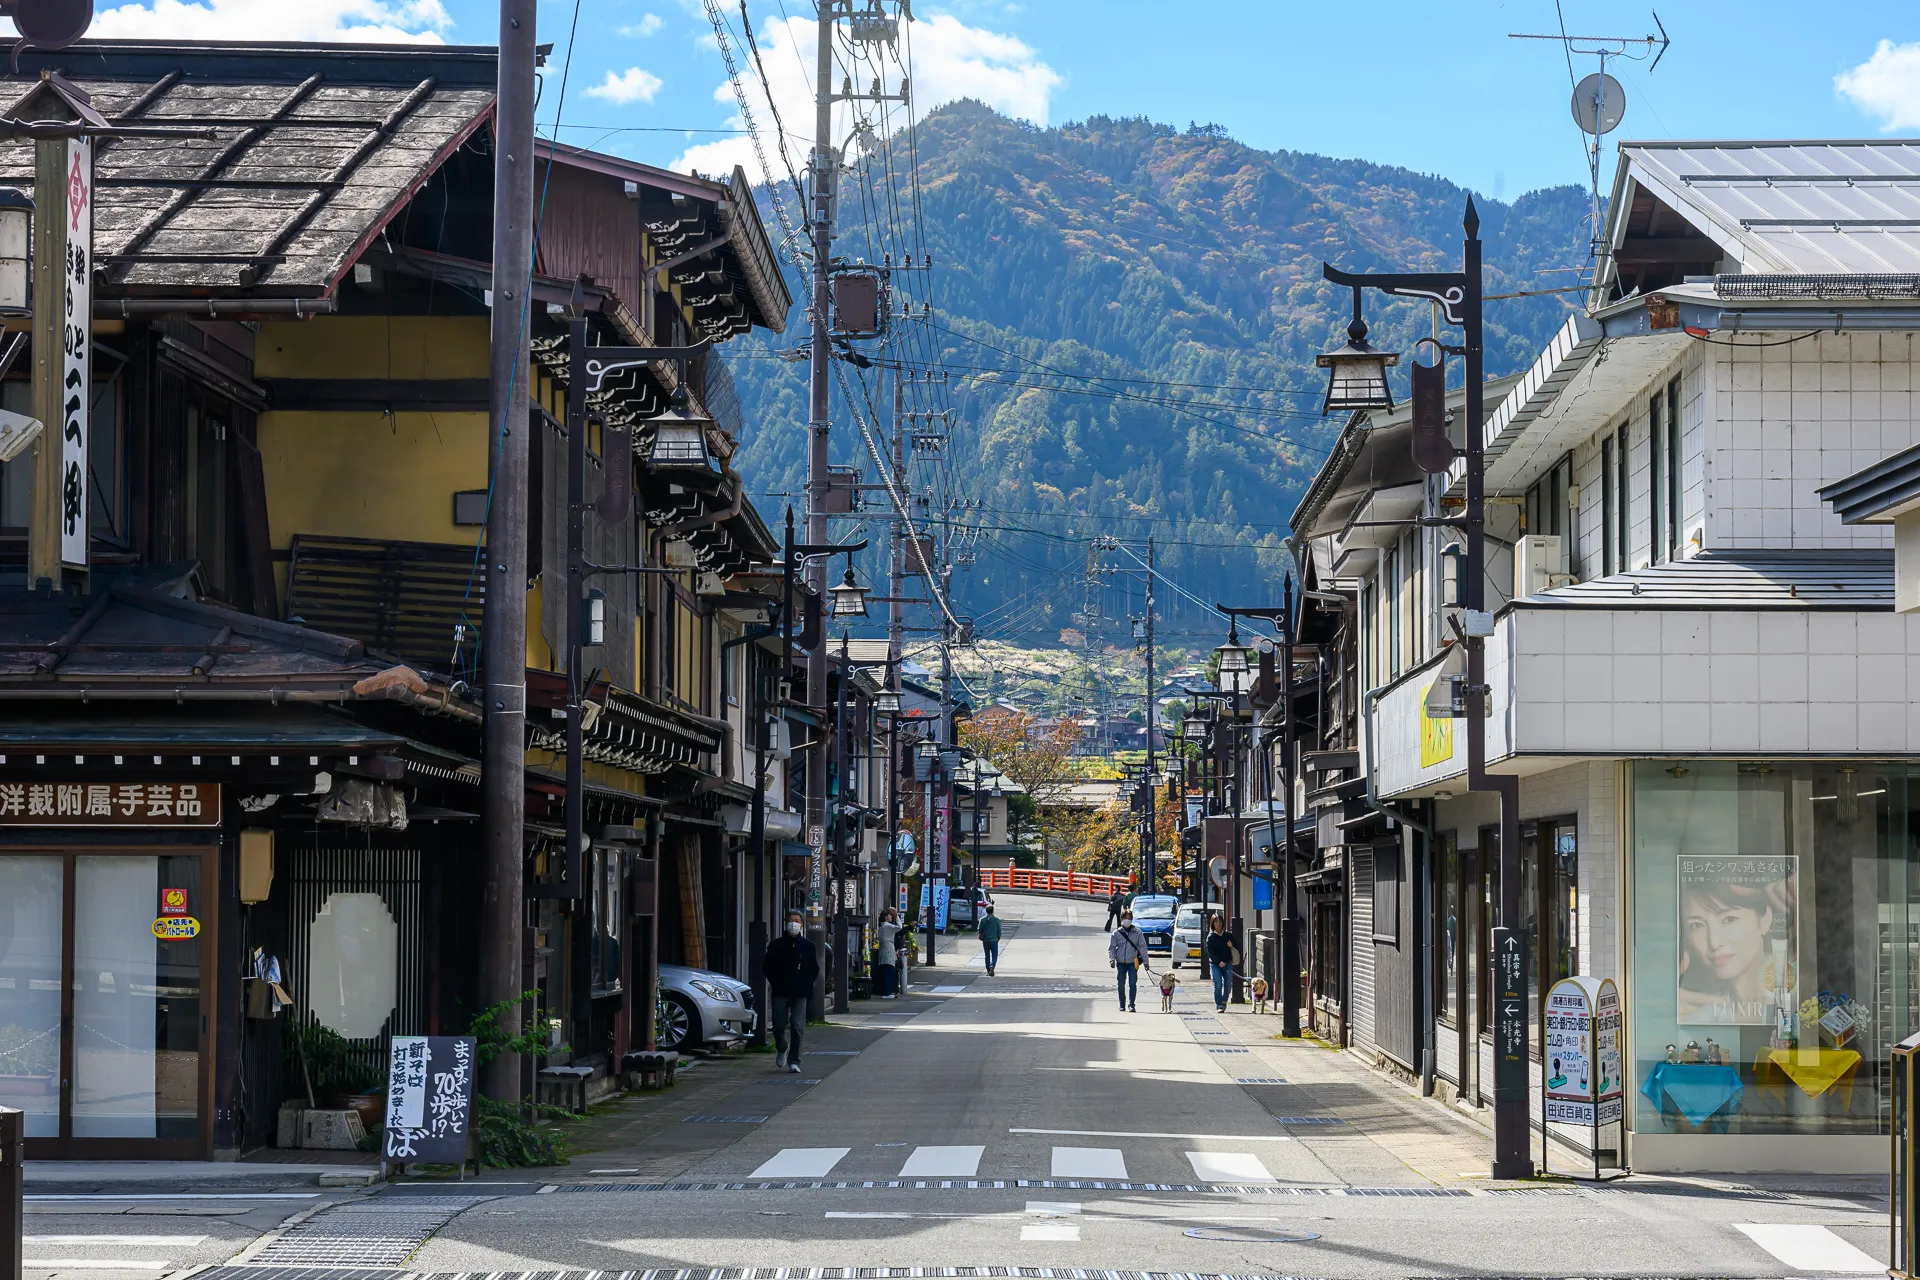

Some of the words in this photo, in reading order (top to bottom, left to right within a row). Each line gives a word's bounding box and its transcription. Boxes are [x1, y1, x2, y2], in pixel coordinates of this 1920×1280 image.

[0, 783, 201, 817] 洋裁附属・手芸品
[1683, 861, 1796, 873] 狙ったシワ、逃さない。
[1513, 1020, 1521, 1046] 本光寺
[408, 1042, 425, 1088] 新そば
[450, 1040, 469, 1133] まっすぐ歩いて
[1548, 1103, 1592, 1120] 田近百貨店
